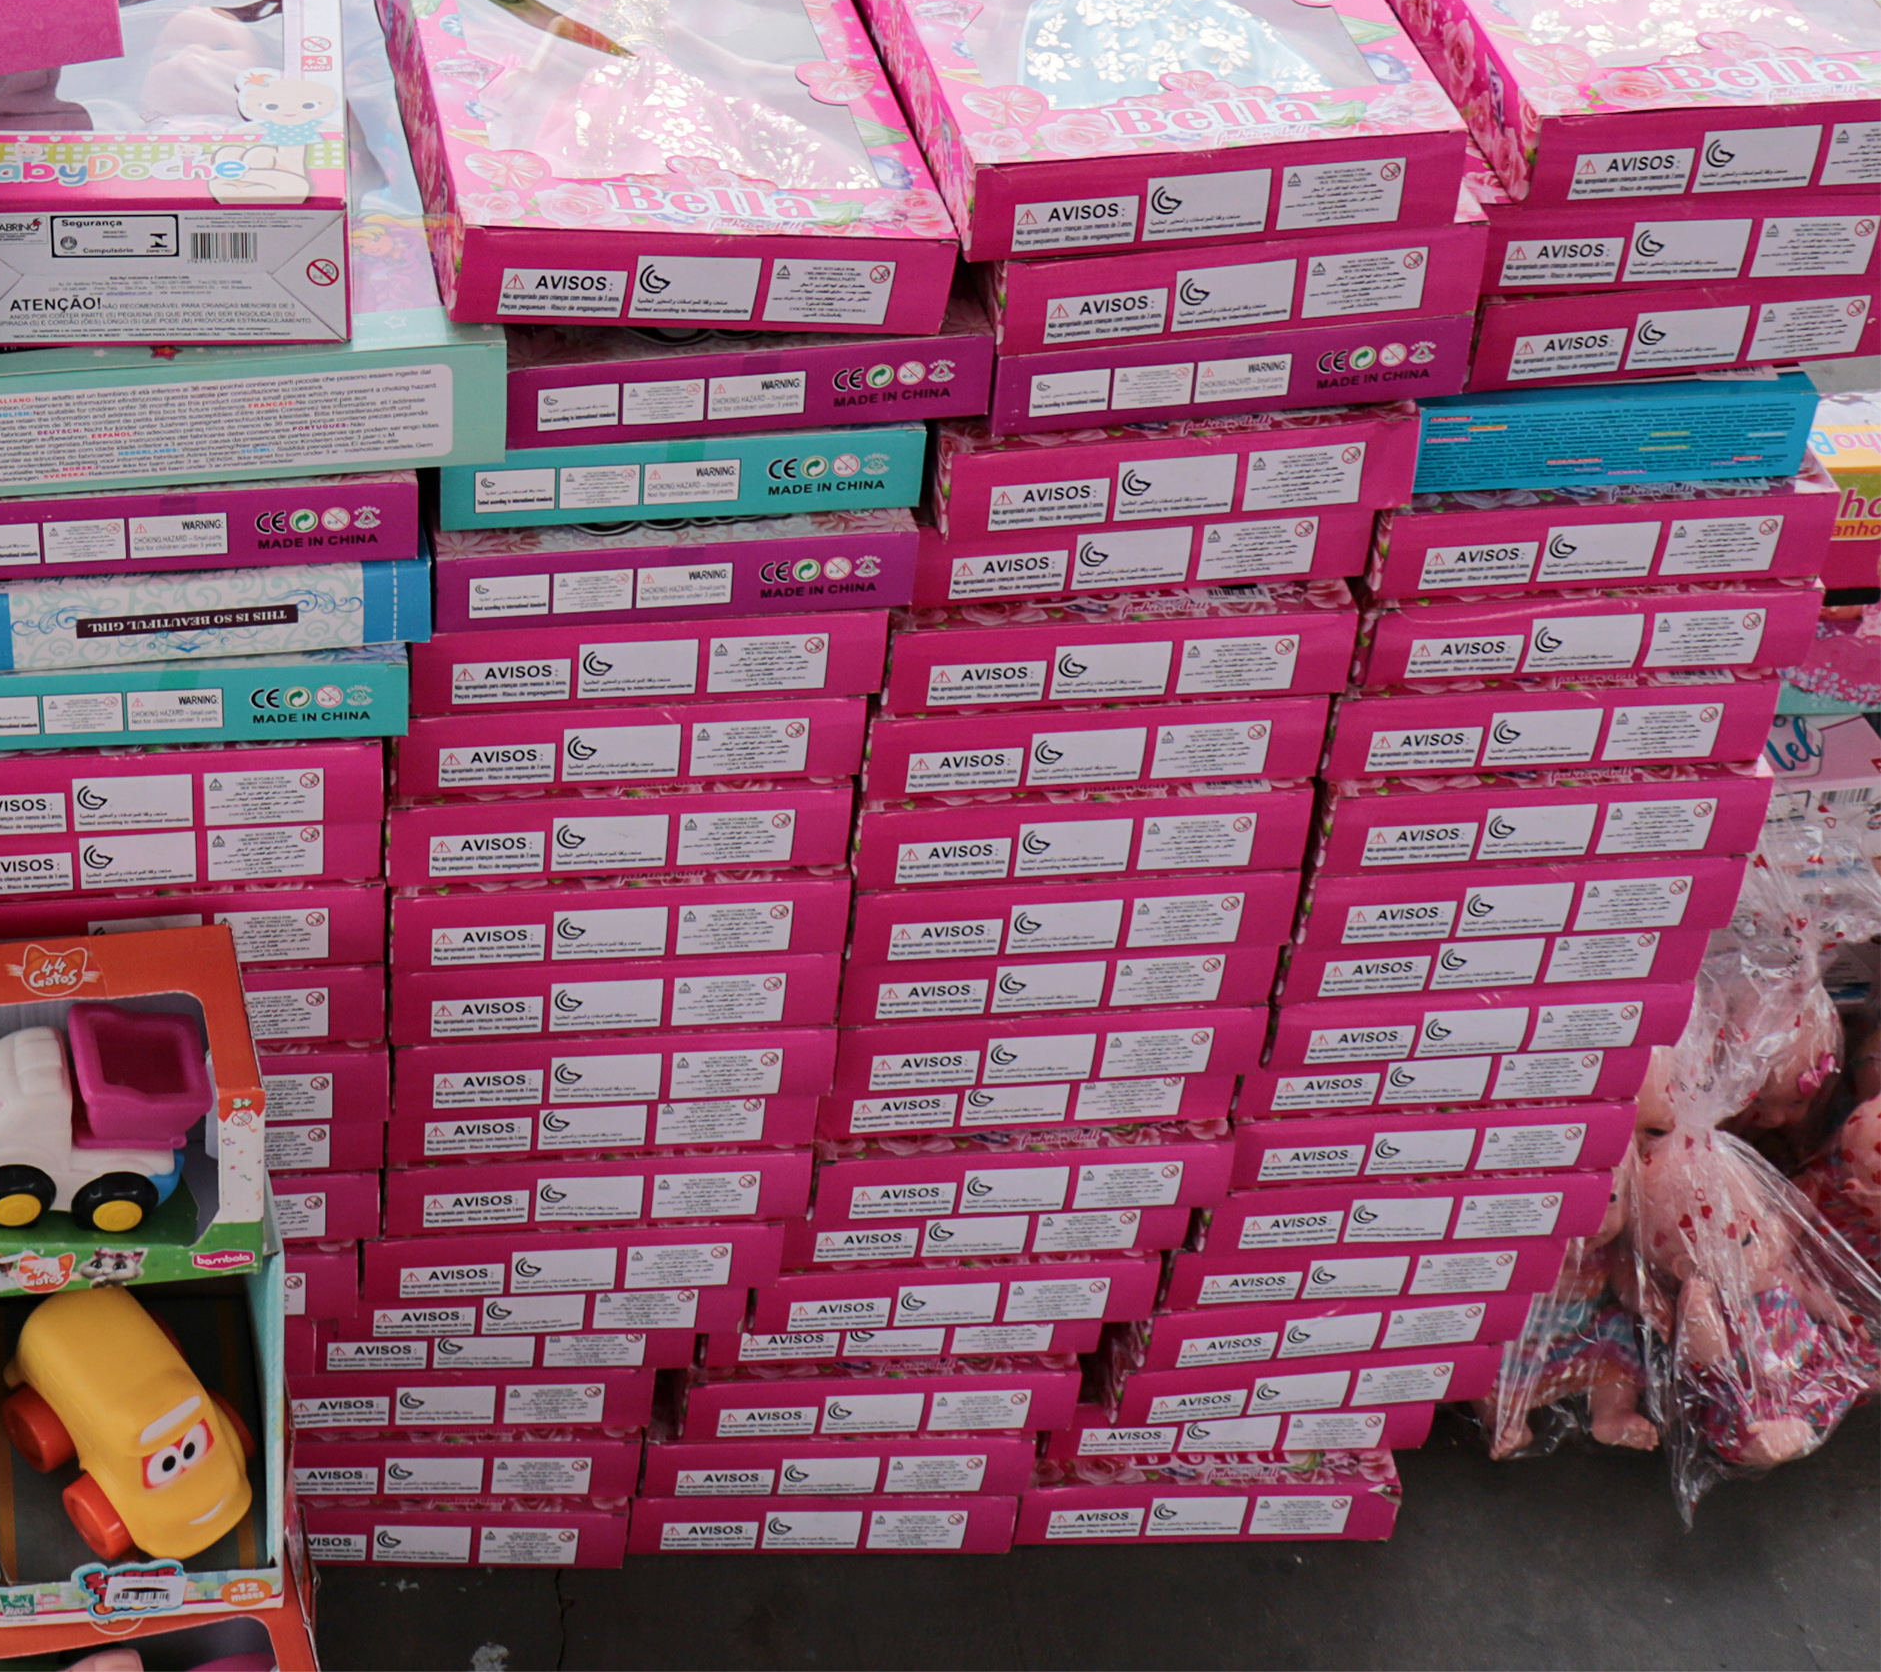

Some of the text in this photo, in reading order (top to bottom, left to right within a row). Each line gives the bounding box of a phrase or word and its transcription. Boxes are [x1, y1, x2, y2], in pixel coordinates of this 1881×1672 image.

[1657, 58, 1867, 93] Bella
[1105, 94, 1323, 141] Bella
[606, 181, 818, 222] Bella
[61, 218, 123, 229] Segurança
[9, 294, 102, 313] ATENÇÃO!
[42, 956, 67, 975] 44
[28, 966, 78, 988] Gatos
[195, 1251, 252, 1266] bambola
[230, 1582, 259, 1594] +12
